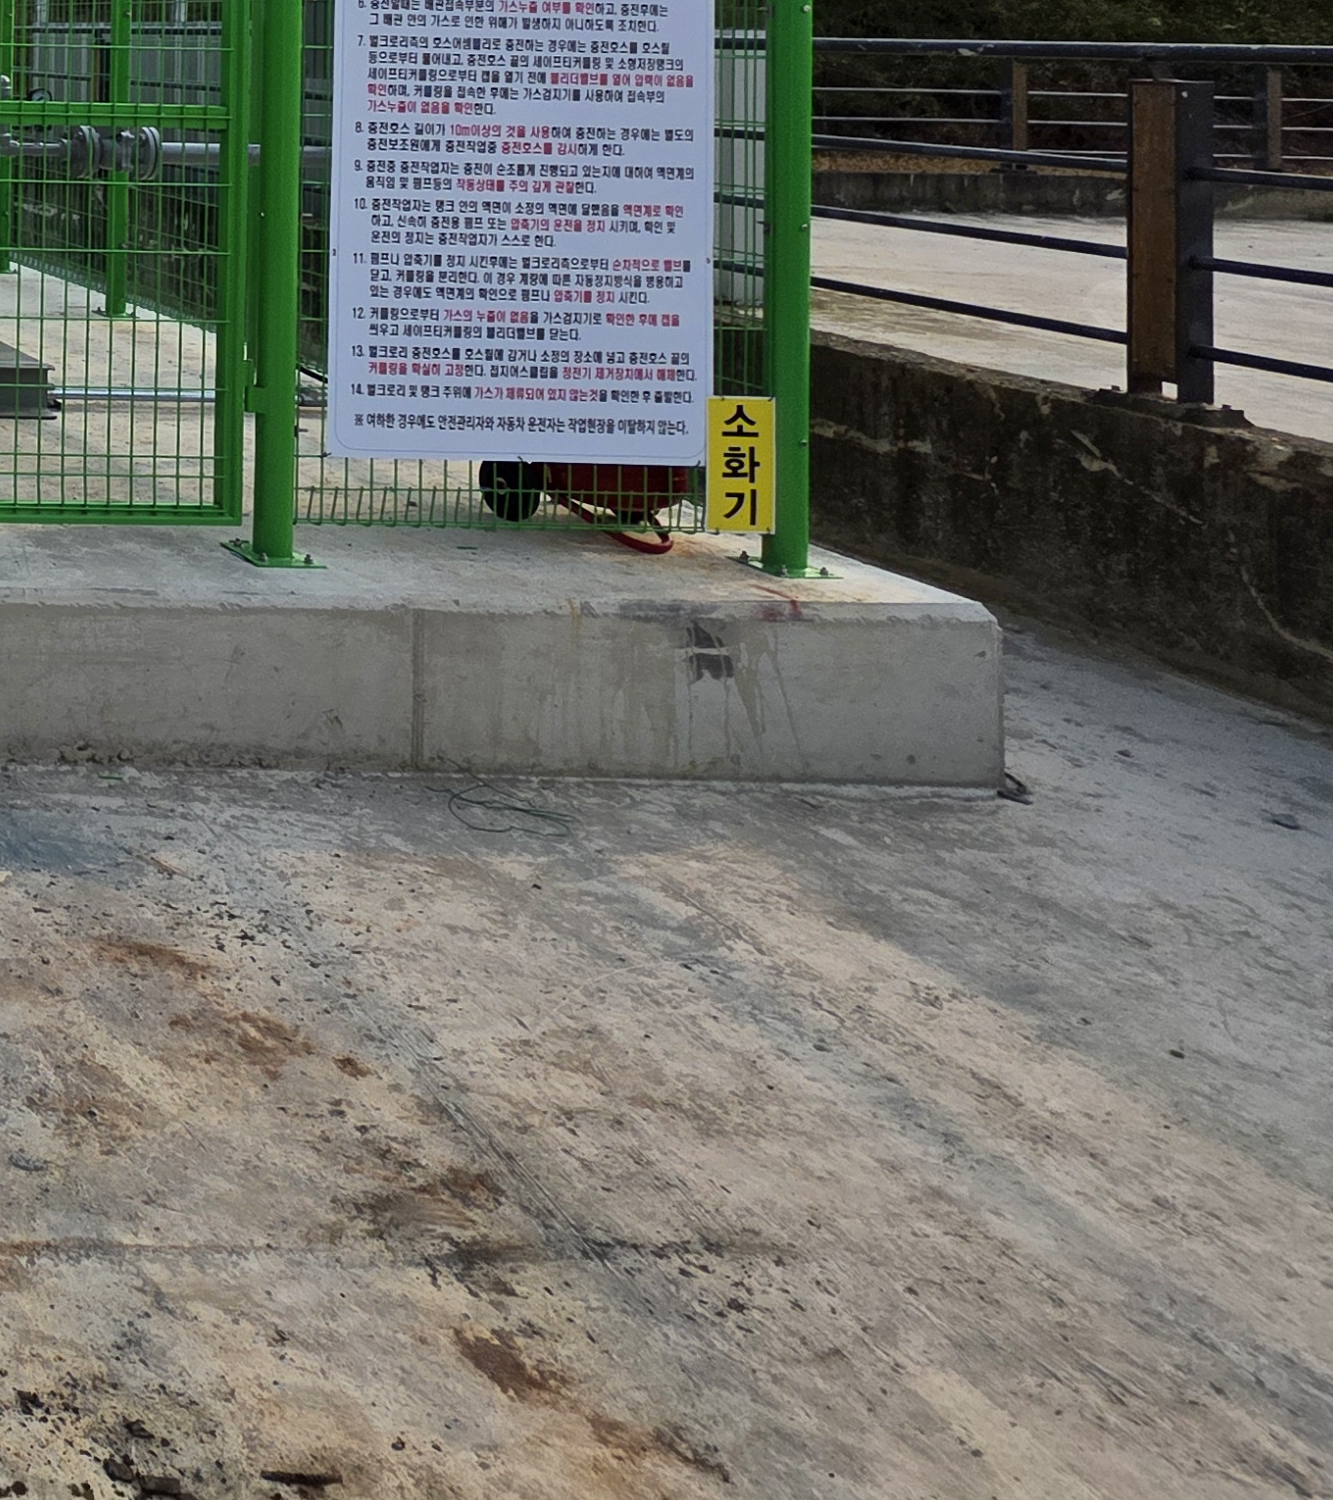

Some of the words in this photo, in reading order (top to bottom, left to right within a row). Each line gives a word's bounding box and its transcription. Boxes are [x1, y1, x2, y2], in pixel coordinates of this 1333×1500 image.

[368, 12, 379, 25] 그
[382, 12, 403, 26] 배관
[406, 13, 427, 27] 안의
[429, 13, 461, 28] 가스로
[463, 14, 484, 29] 인한
[487, 15, 518, 30] 위해가
[520, 16, 561, 31] 발생하지
[617, 18, 660, 33] 조치한다.
[366, 99, 417, 114] 가스누출이
[419, 100, 450, 115] 없음을
[453, 101, 497, 116] 확인한다.
[365, 174, 395, 189] 움직임
[398, 176, 409, 190] 및
[455, 177, 505, 193] 작동상태를
[508, 178, 529, 193] 주의
[531, 179, 552, 194] 깊게
[554, 179, 597, 195] 관찰한다.
[370, 229, 401, 244] 운전의
[403, 230, 435, 245] 정지는
[437, 231, 498, 247] 충전작업자가
[498, 233, 531, 247] 스스로
[533, 234, 557, 248] 한다.
[548, 326, 582, 342] 닫는다.
[365, 411, 396, 429] 여하한
[397, 413, 436, 430] 경우에도
[436, 413, 495, 431] 안전관리자와
[495, 415, 526, 432] 자동차
[526, 415, 566, 433] 운전자는
[566, 417, 616, 434] 작업현장을
[616, 418, 655, 435] 이탈하지
[656, 419, 689, 436] 않는다.
[722, 405, 760, 525] 소화기
